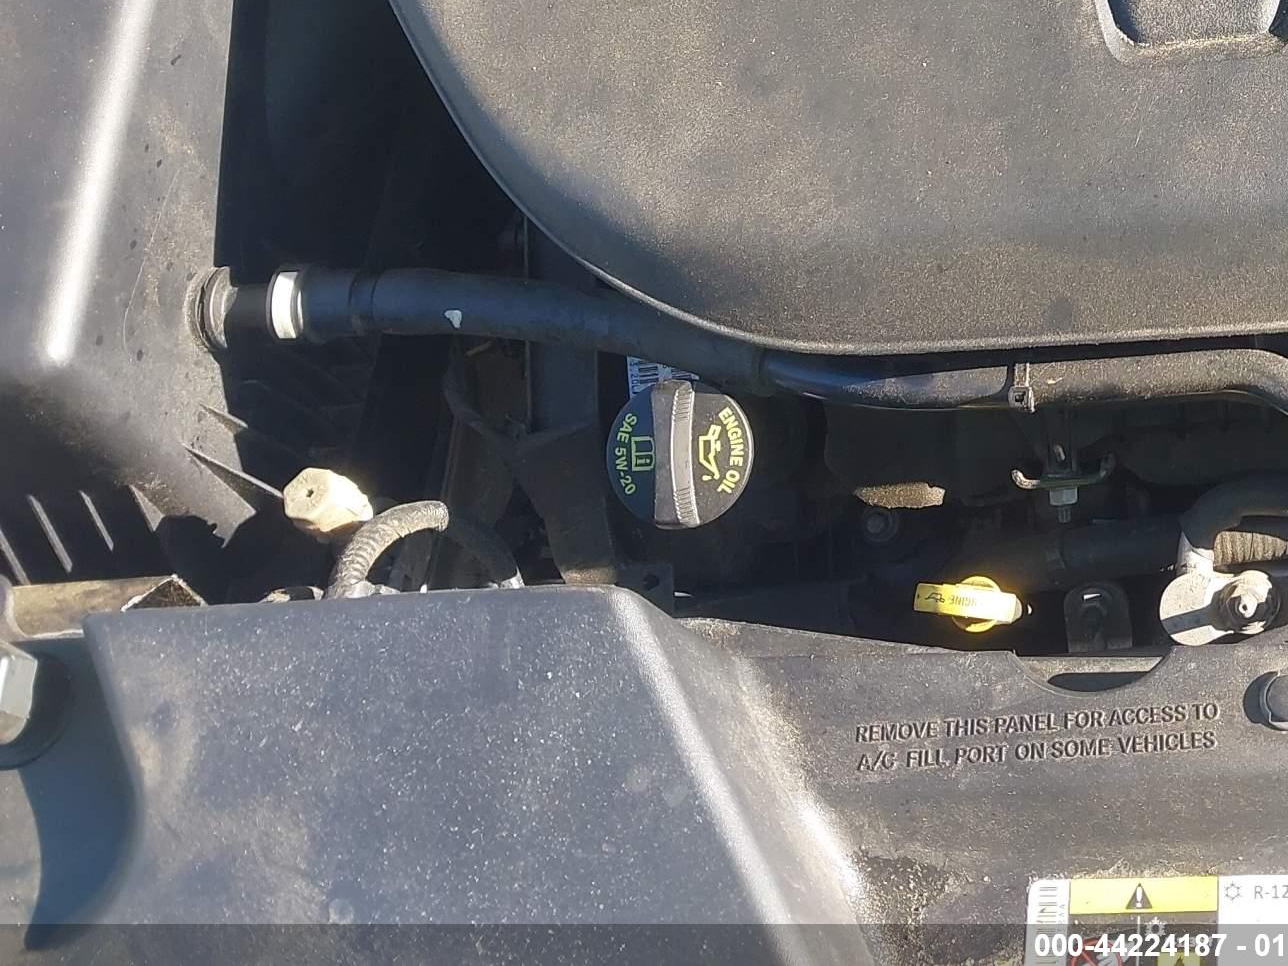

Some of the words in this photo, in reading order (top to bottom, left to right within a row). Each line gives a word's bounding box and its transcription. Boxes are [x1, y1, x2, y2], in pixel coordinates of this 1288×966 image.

[617, 413, 637, 443] SAE
[718, 407, 744, 467] ENGINE
[615, 448, 636, 495] 5W-20
[717, 470, 741, 494] OIL
[855, 720, 939, 743] REMOVE
[943, 717, 989, 738] THIS
[994, 713, 1060, 733] PANEL
[1064, 709, 1105, 730] FOR
[1109, 704, 1188, 727] ACCESS
[1192, 702, 1220, 721] TO
[856, 749, 898, 771] A/C
[906, 747, 949, 768] FILL
[955, 744, 1009, 765] PORT
[1014, 742, 1047, 762] ON
[1051, 738, 1113, 759] SOME
[1117, 730, 1218, 754] VEHICLES
